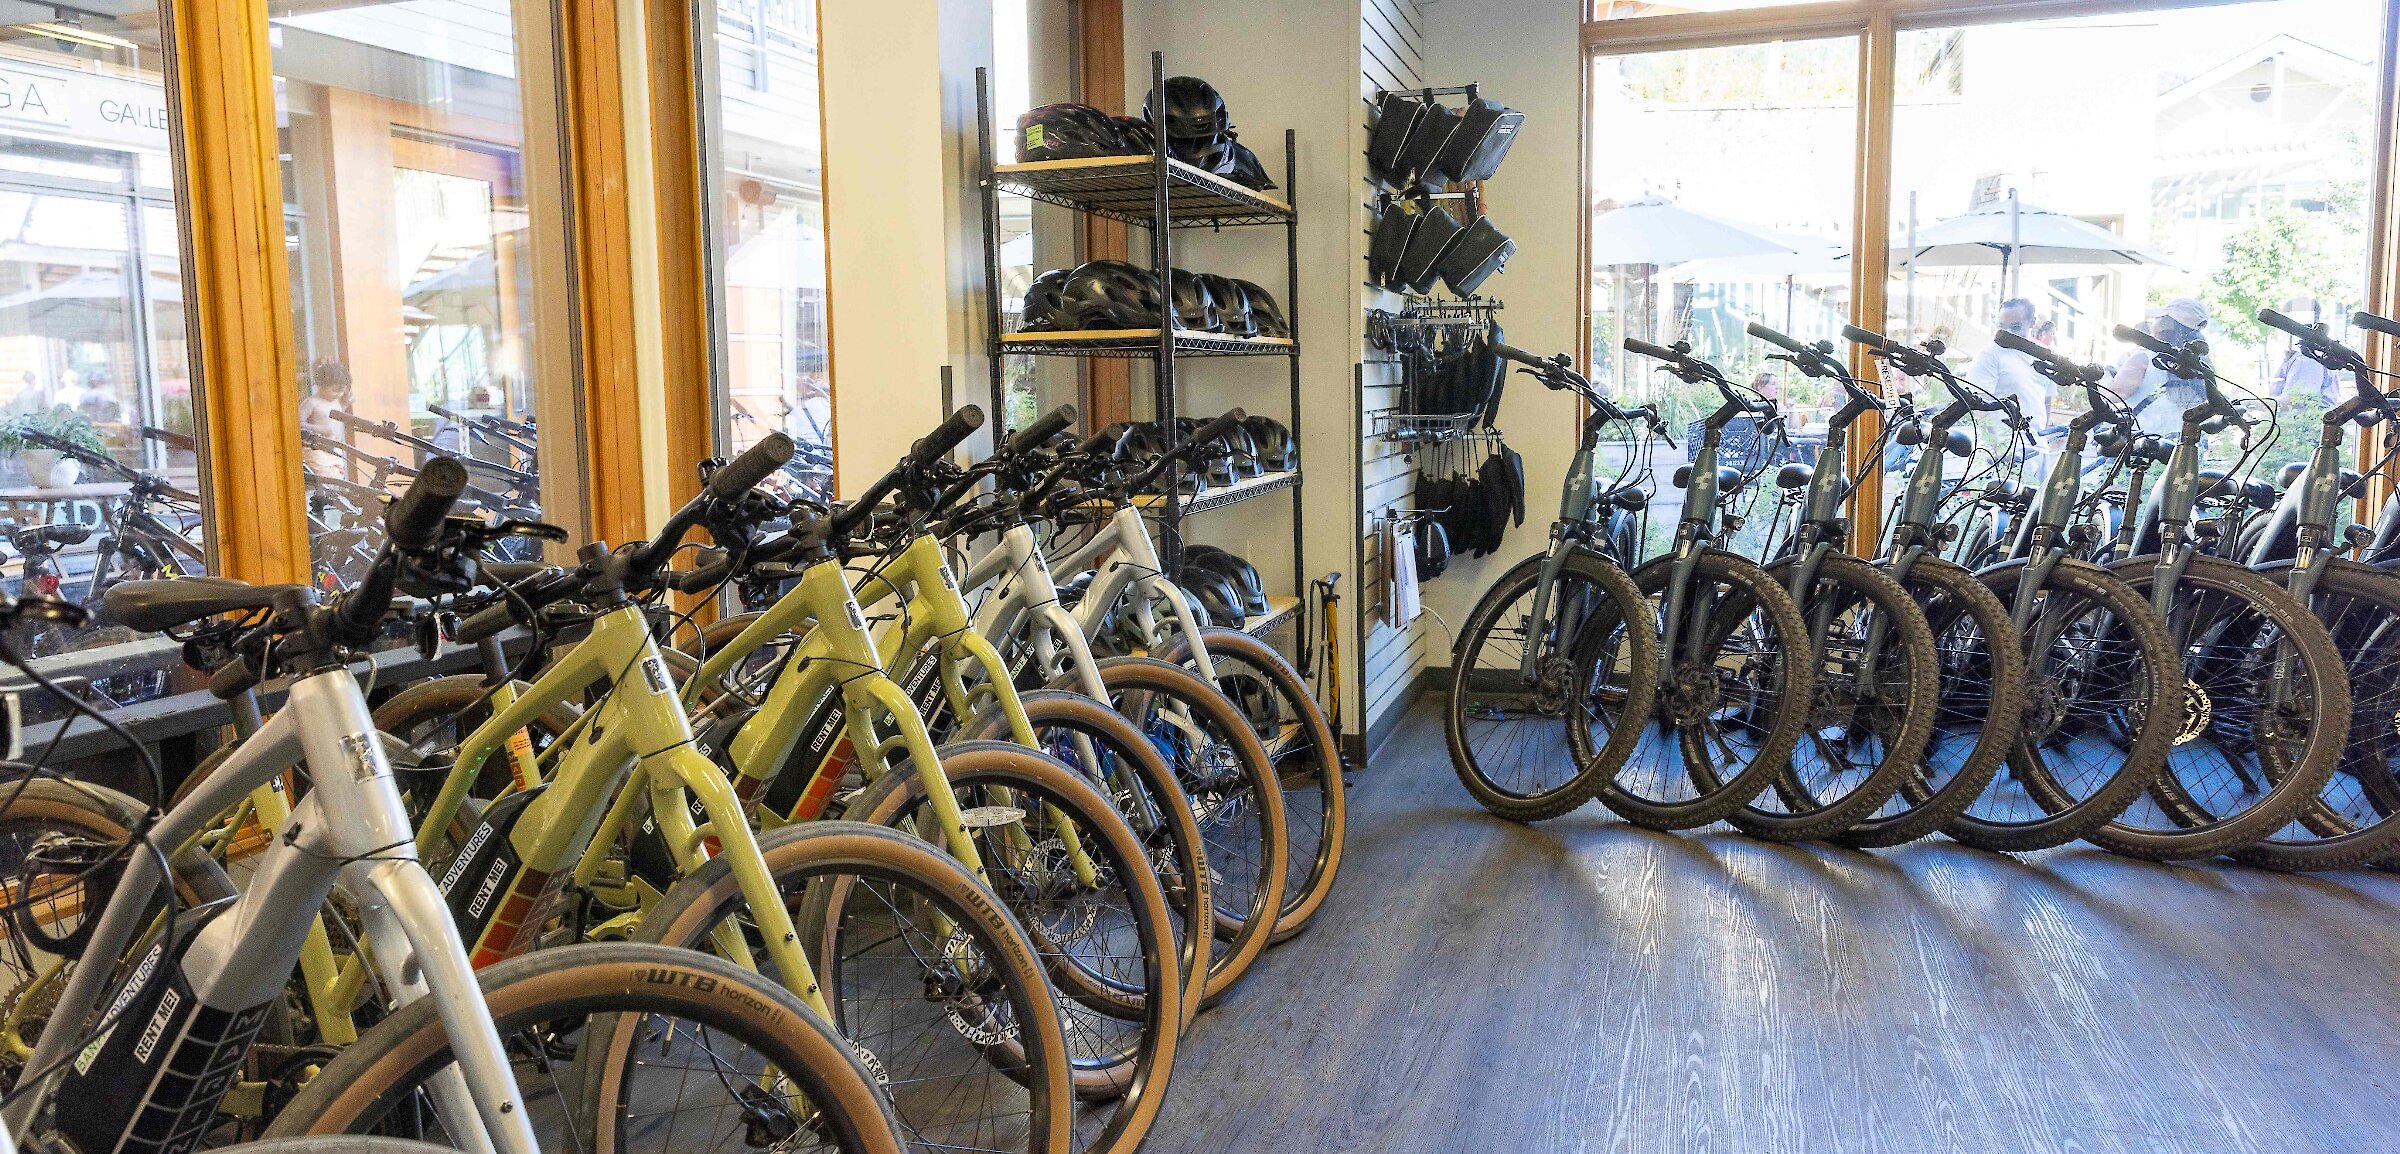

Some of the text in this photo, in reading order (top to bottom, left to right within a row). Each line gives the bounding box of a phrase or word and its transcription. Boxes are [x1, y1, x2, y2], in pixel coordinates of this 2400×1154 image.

[906, 656, 937, 697] DVENTURES
[813, 728, 830, 752] RENT
[827, 708, 842, 728] ME!
[443, 824, 492, 892] ADVENTURES
[470, 858, 506, 916] RENT ME!
[966, 890, 1028, 968] WTB horizon
[647, 967, 772, 1017] WTB horizon
[136, 990, 177, 1061] RENT ME!
